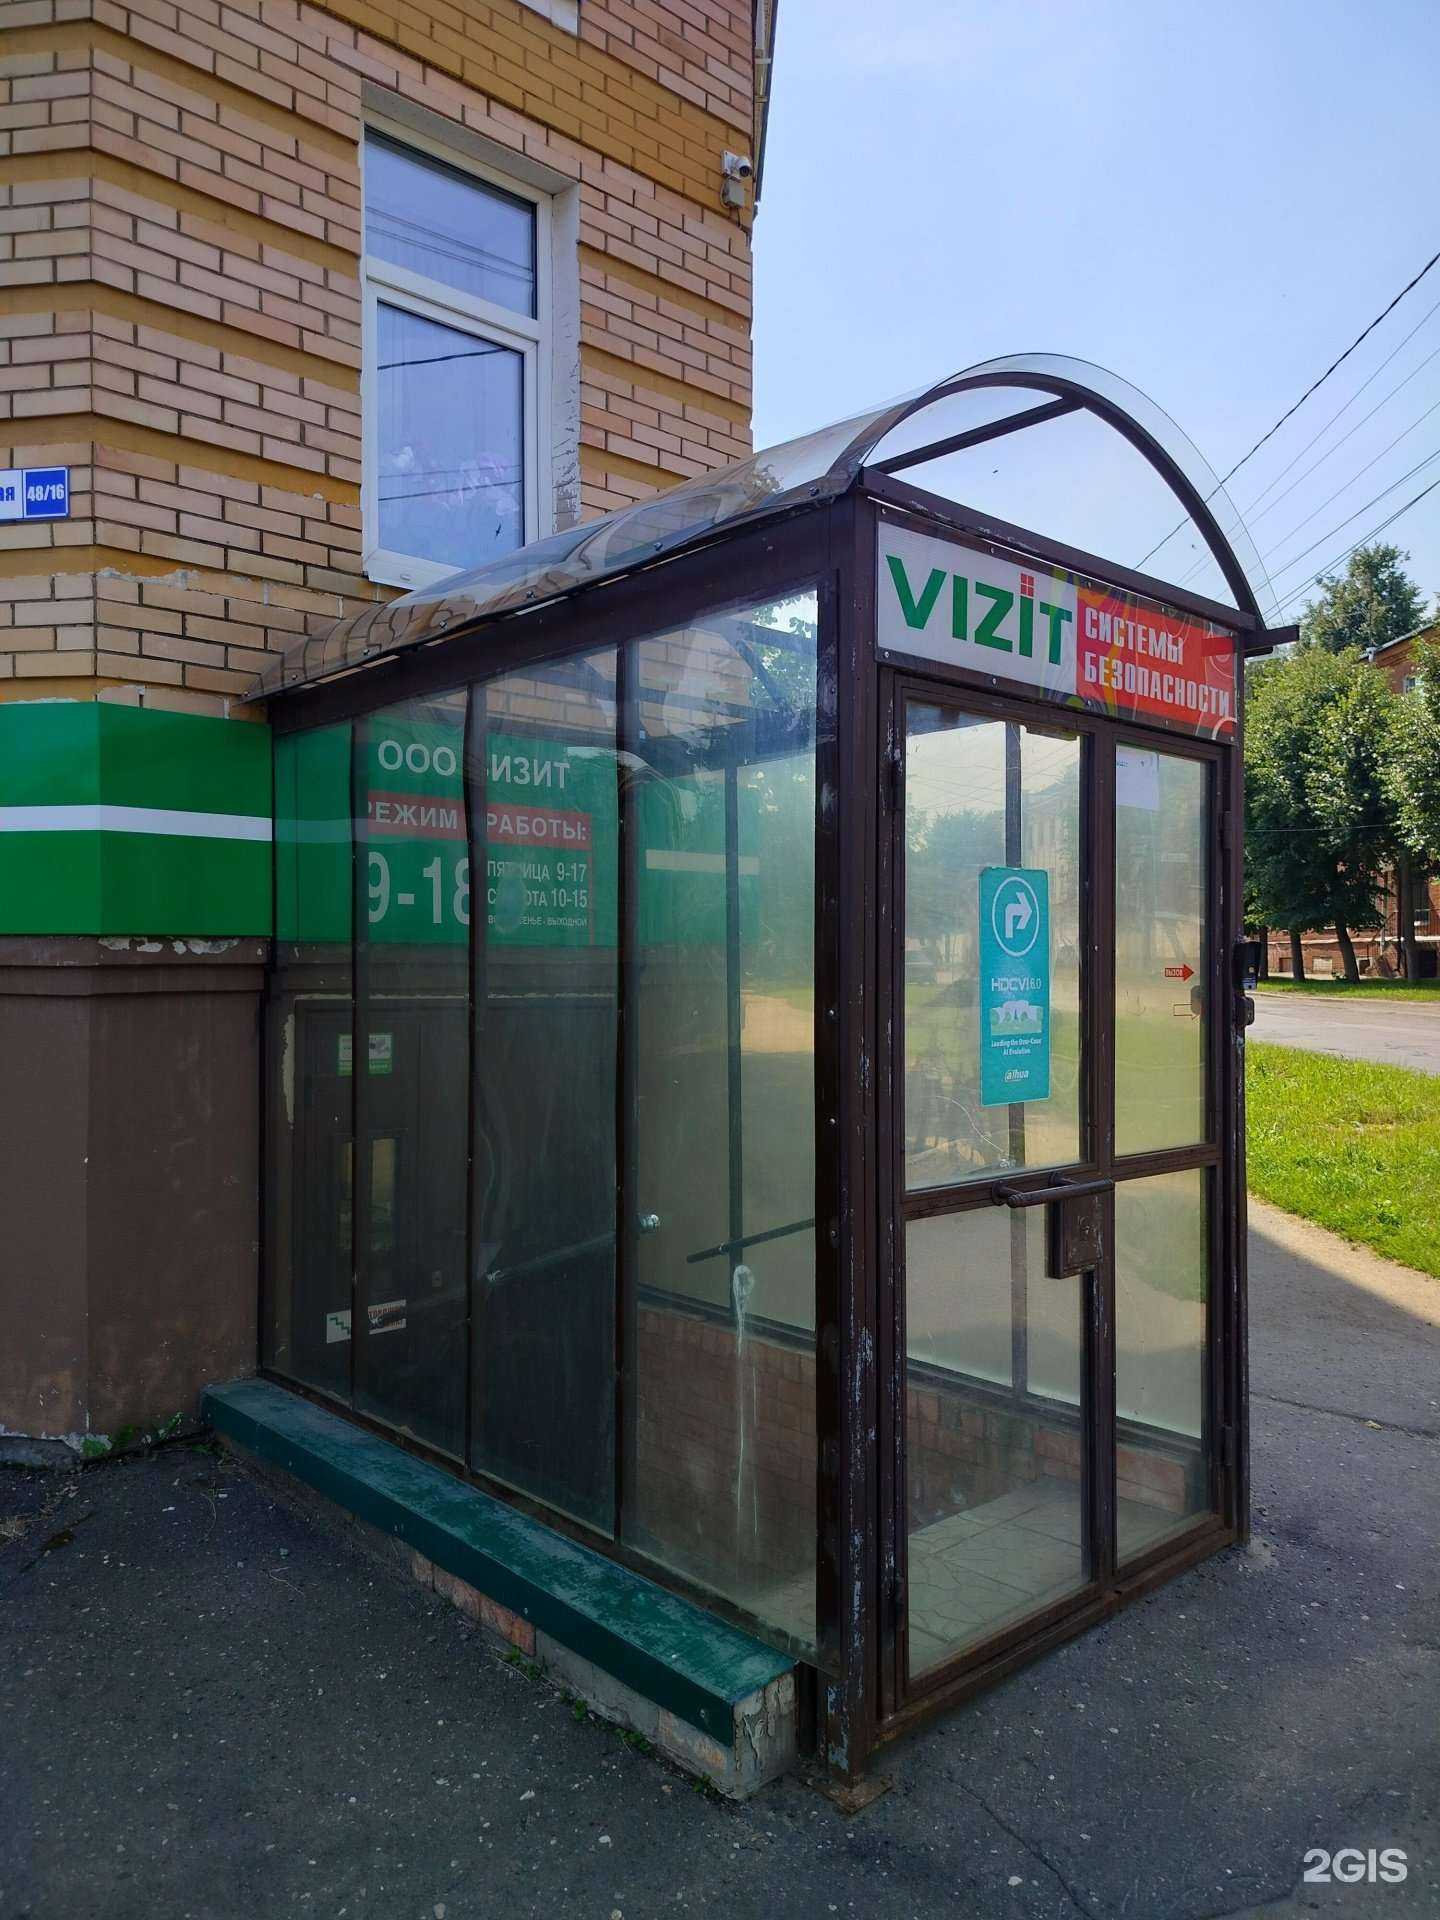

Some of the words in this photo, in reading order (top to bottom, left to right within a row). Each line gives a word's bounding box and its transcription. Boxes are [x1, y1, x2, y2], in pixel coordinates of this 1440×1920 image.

[27, 483, 65, 501] 48/16
[1084, 607, 1184, 665] СИСТЕМЫ
[1083, 651, 1230, 717] БЕЗОПАСНОСТИ
[378, 740, 457, 776] ООО
[486, 753, 570, 789] ИЗИТ
[486, 812, 587, 840] РАБОТЫ:
[556, 862, 587, 882] 9-17
[552, 888, 588, 908] 10-15
